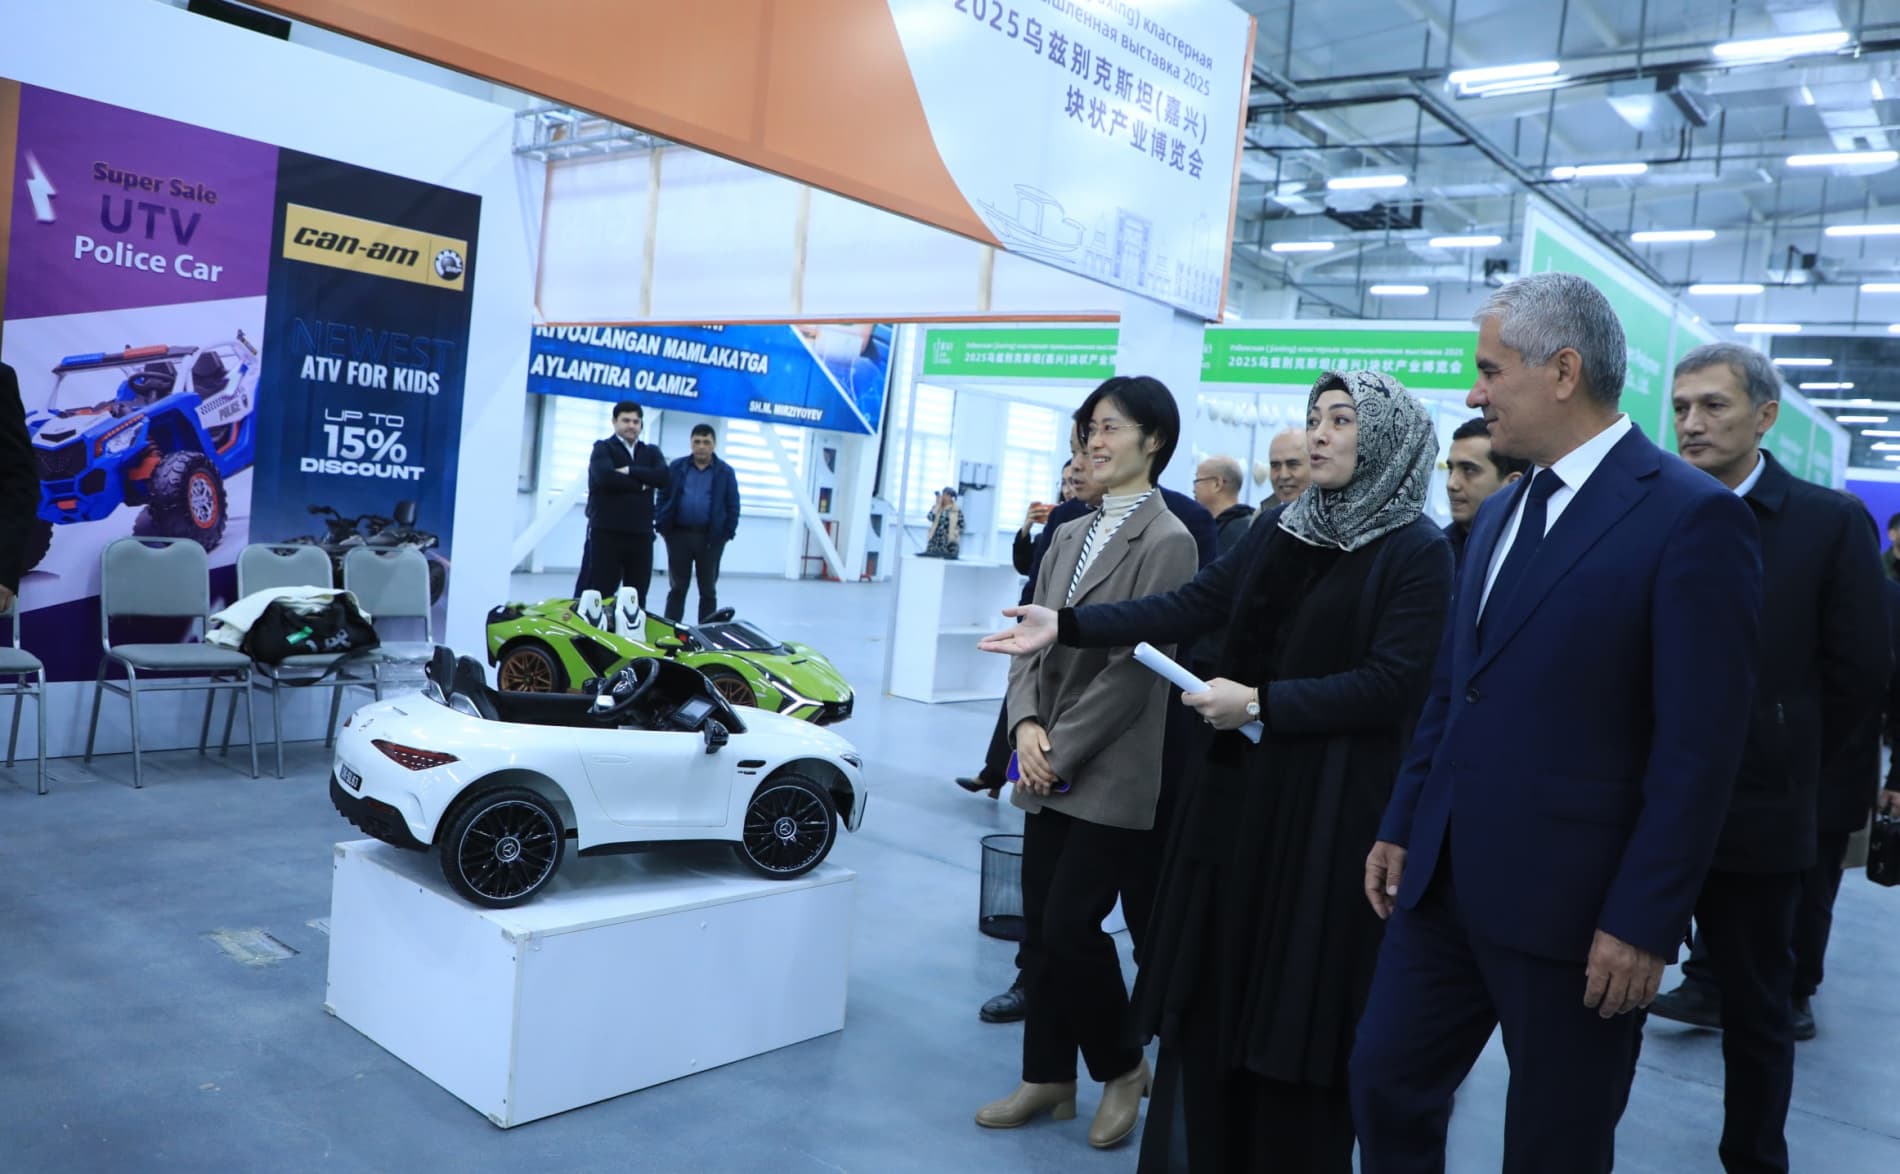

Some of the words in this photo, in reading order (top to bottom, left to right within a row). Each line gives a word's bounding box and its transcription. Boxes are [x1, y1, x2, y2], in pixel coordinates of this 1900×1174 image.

[1121, 34, 1181, 80] выставка
[1183, 68, 1210, 97] 2025
[1143, 17, 1213, 71] кластерная
[1064, 84, 1204, 180] 块状产业博览会
[93, 161, 163, 192] Super
[169, 178, 217, 204] Sale
[101, 194, 201, 247] UTV
[74, 235, 167, 273] Police
[174, 254, 223, 282] Car
[293, 227, 420, 267] can-am
[292, 316, 457, 374] NEWEST
[663, 337, 769, 374] MAMLAKATGA
[300, 355, 342, 383] ATV
[347, 360, 388, 390] FOR
[393, 367, 440, 396] KIDS
[530, 354, 631, 388] AYLANTIRA
[635, 370, 700, 397] OLAMIZ.
[325, 407, 363, 422] UP
[368, 412, 405, 428] TO
[323, 424, 407, 464] 15%
[300, 457, 425, 481] DISCOUNT
